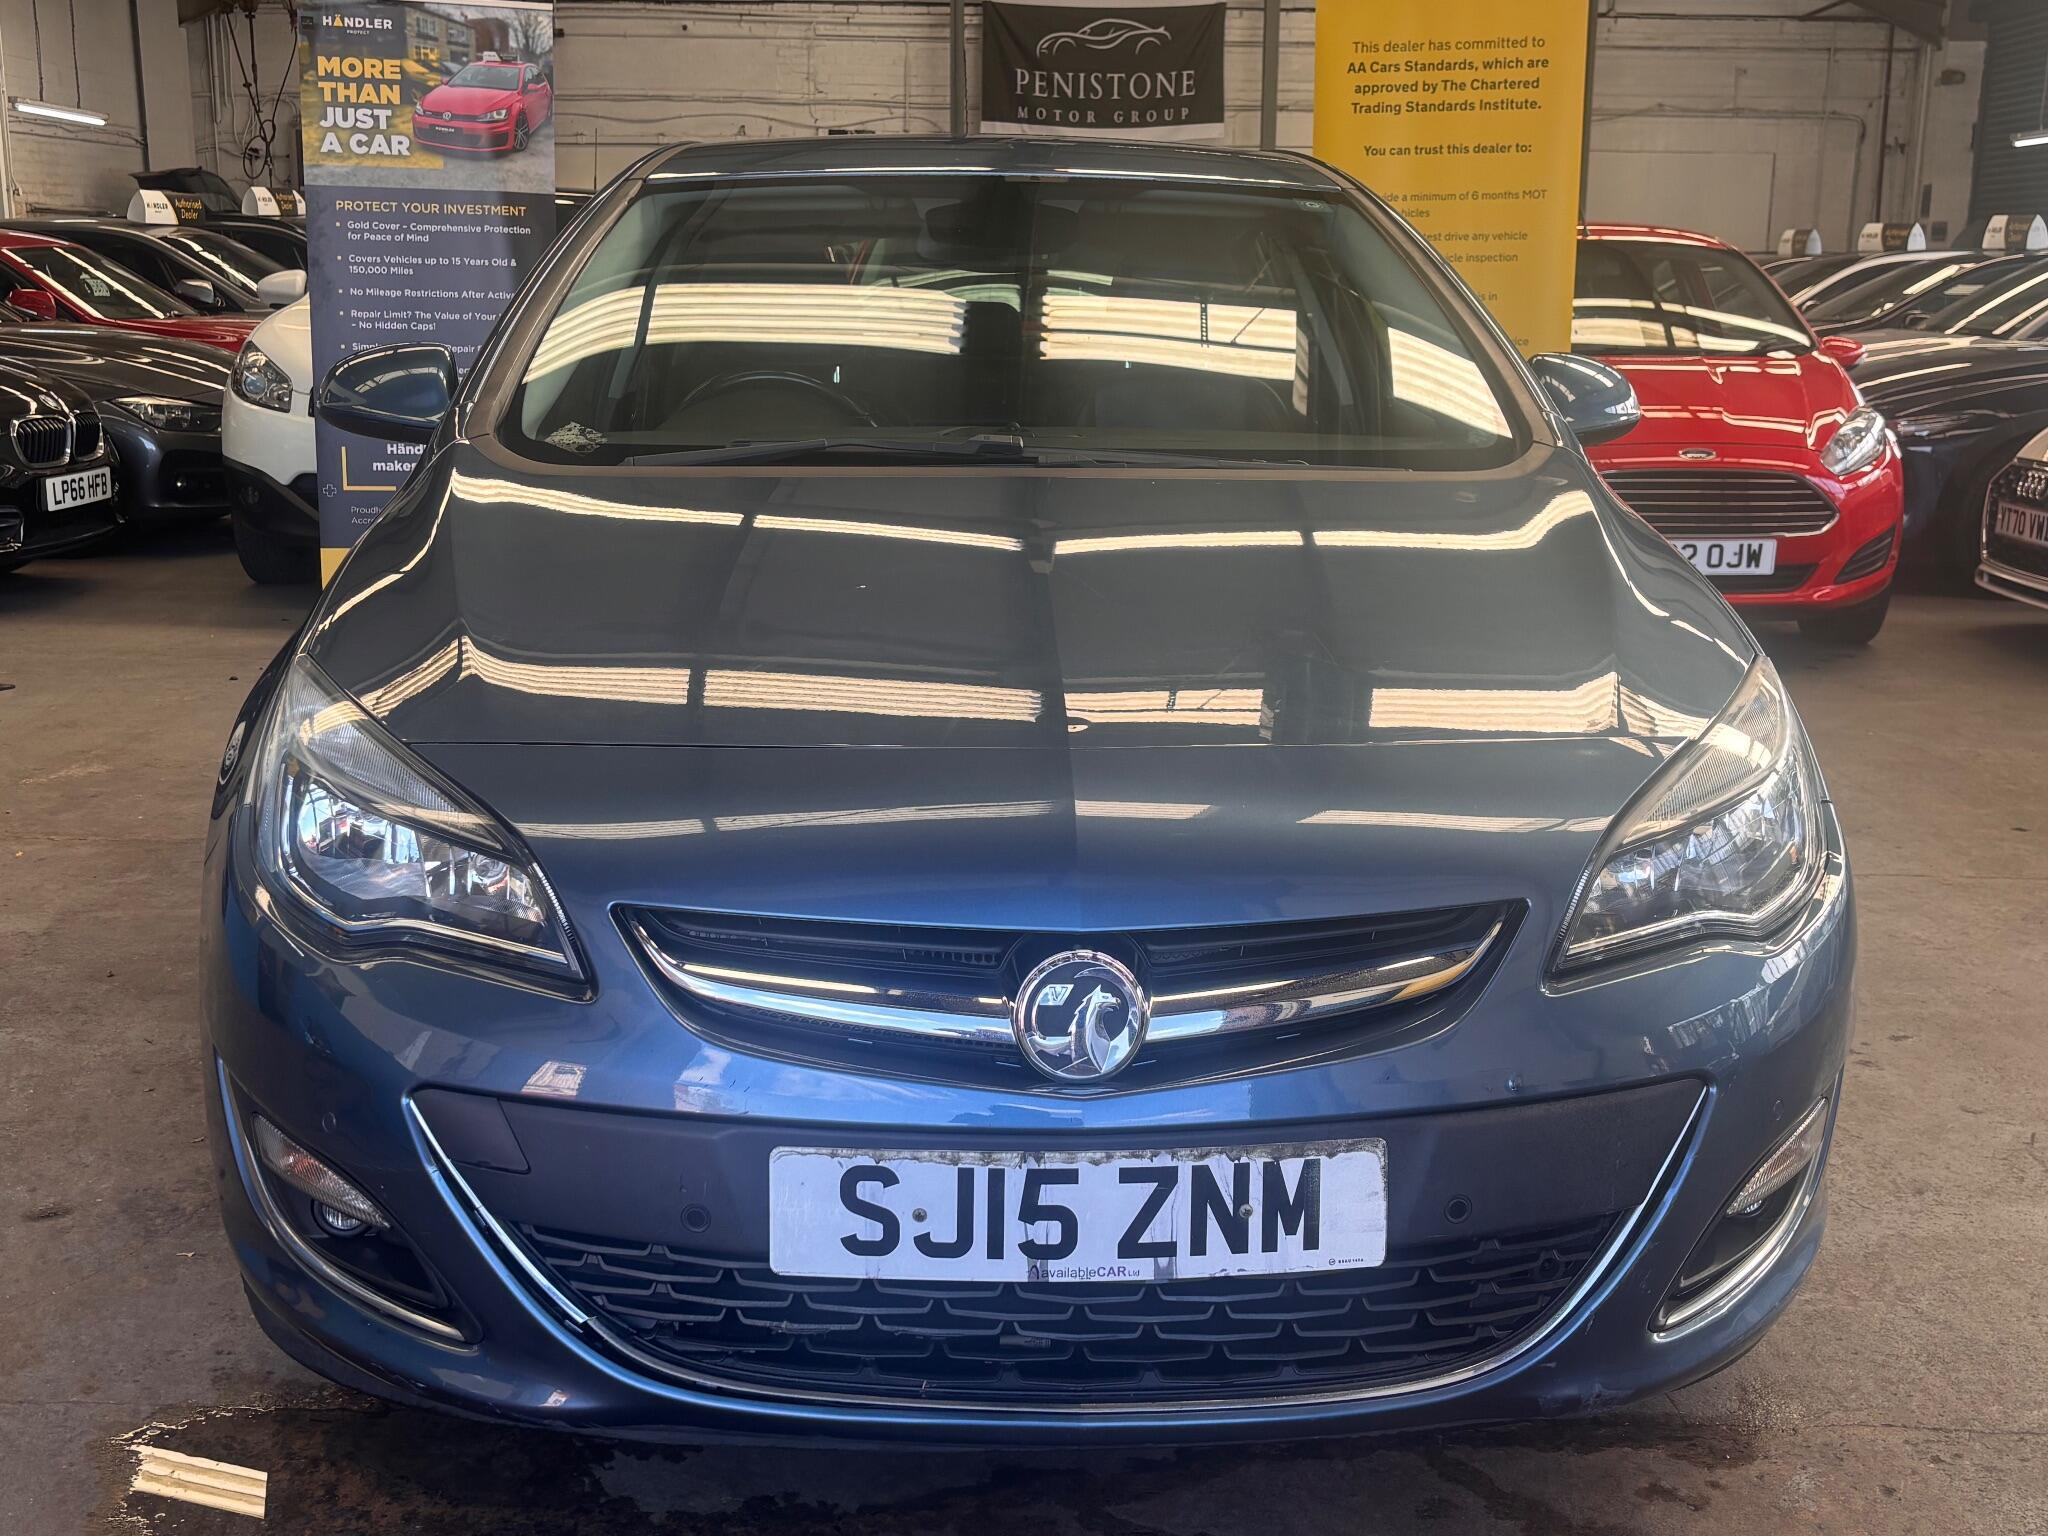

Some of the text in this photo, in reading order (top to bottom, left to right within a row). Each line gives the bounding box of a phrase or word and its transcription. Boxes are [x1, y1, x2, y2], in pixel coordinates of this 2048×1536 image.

[1353, 36, 1546, 53] This dealer has committed to
[317, 55, 401, 80] MORE
[1347, 58, 1549, 74] AA Cars Standards, which are
[1015, 68, 1196, 100] PENISTONE
[1354, 77, 1540, 96] approved by The Chartered
[317, 81, 401, 105] THAN
[1351, 98, 1542, 115] Trading Standards Institute.
[319, 106, 392, 130] JUST
[1017, 106, 1190, 124] MOTOR GROUP
[320, 131, 411, 156] A CAR
[1364, 142, 1532, 157] You can trust this dealer to:
[1410, 192, 1457, 201] minimum
[1459, 191, 1469, 200] of
[1472, 190, 1479, 200] 6
[1481, 190, 1520, 200] months
[1522, 189, 1548, 199] MOT
[335, 200, 527, 217] PROTECT YOUR INVESTMENT
[1401, 208, 1431, 218] hicles
[347, 221, 370, 231] Gold
[372, 221, 400, 231] Cover
[410, 222, 482, 234] Comprehensive
[483, 224, 531, 235] Protection
[347, 232, 429, 243] for Peace of Mind
[1444, 231, 1471, 241] drive
[1472, 232, 1489, 243] any
[1491, 231, 1528, 241] vehicle
[348, 254, 517, 267] Covers Vehicles up to 15 Years Old &
[1466, 252, 1519, 265] inspection
[348, 265, 414, 276] 150,000 Miles
[350, 288, 364, 297] No
[366, 288, 402, 299] Mileage
[404, 289, 459, 299] Restrictions
[461, 290, 486, 299] After
[1488, 292, 1498, 301] in
[350, 309, 382, 321] Repair
[383, 310, 412, 319] Limit?
[414, 311, 432, 320] The
[434, 311, 460, 321] Value
[462, 312, 473, 321] of
[474, 312, 497, 321] Your
[359, 321, 372, 330] No
[374, 321, 408, 331] Hidden
[409, 322, 436, 332] Caps!
[52, 472, 108, 506] LP66 HFB
[1706, 543, 1764, 569] OJW
[839, 1158, 1322, 1261] SJ15 ZNM
